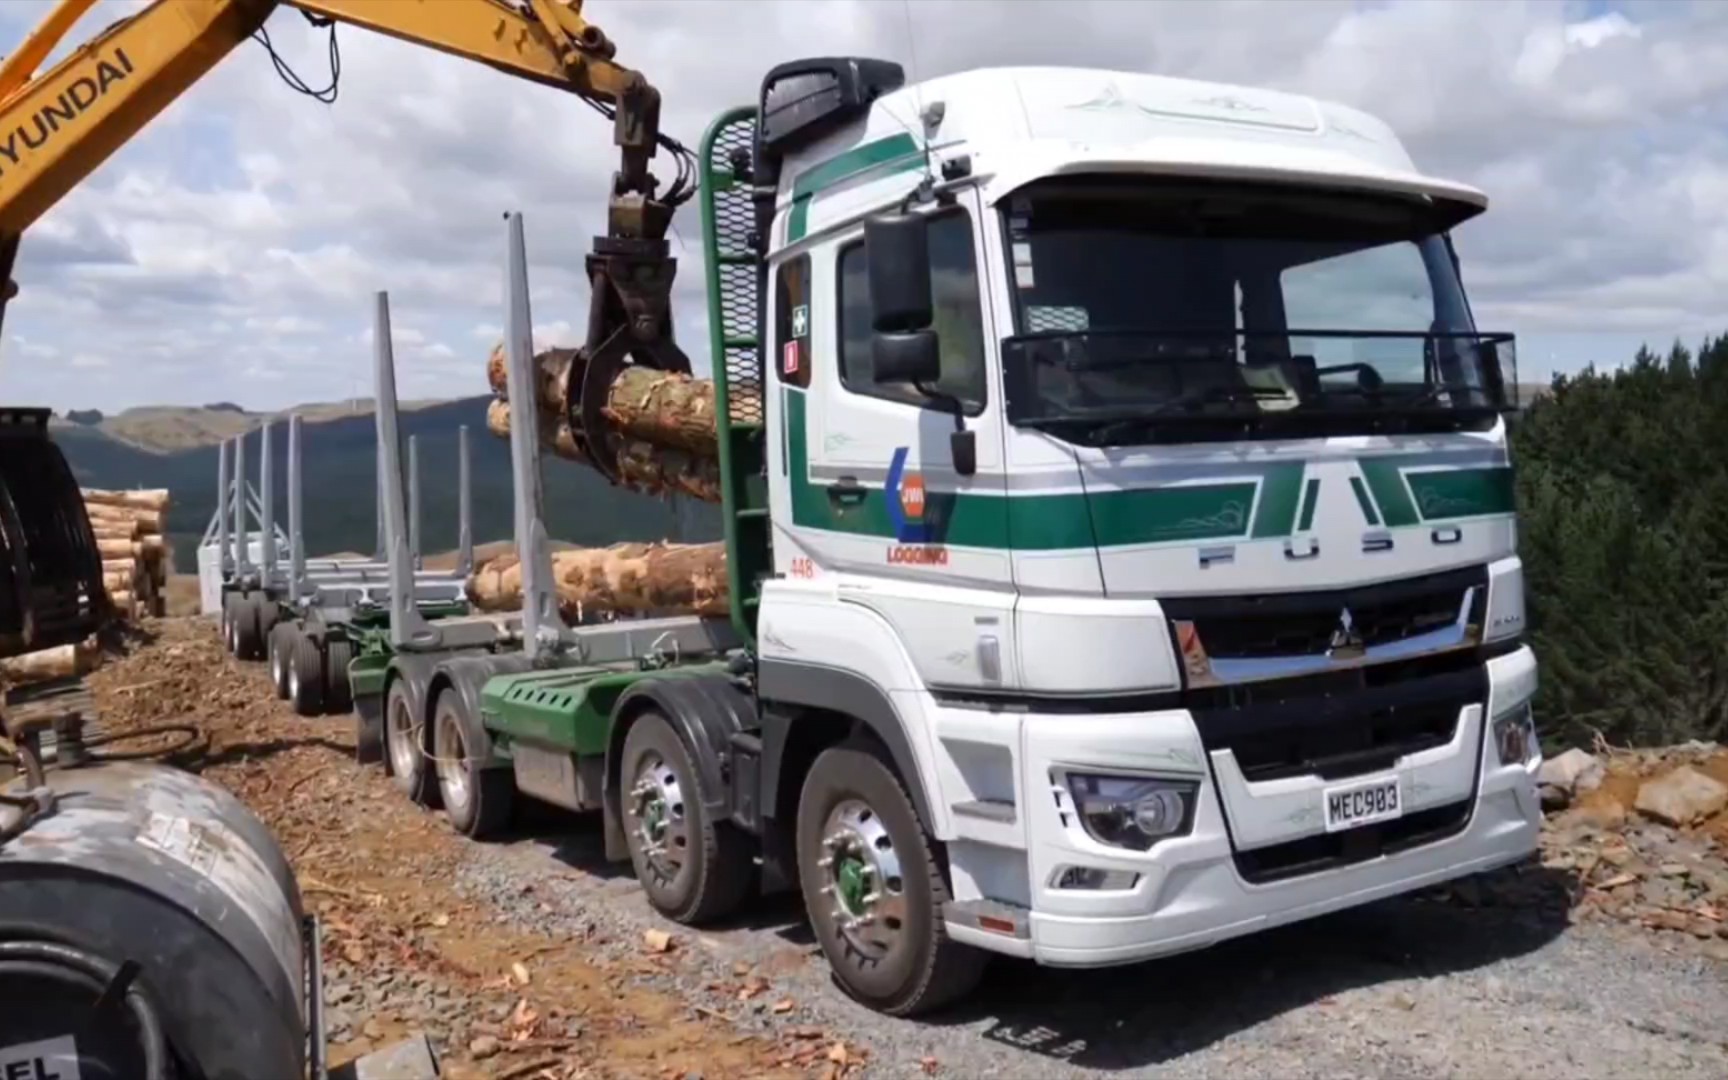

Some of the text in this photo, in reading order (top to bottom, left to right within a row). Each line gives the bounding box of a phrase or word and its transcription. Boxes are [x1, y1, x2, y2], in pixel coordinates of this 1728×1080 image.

[0, 47, 134, 177] YUNDAI
[887, 546, 949, 565] LOGGING
[1198, 525, 1463, 569] FUSO
[0, 1057, 61, 1080] EL
